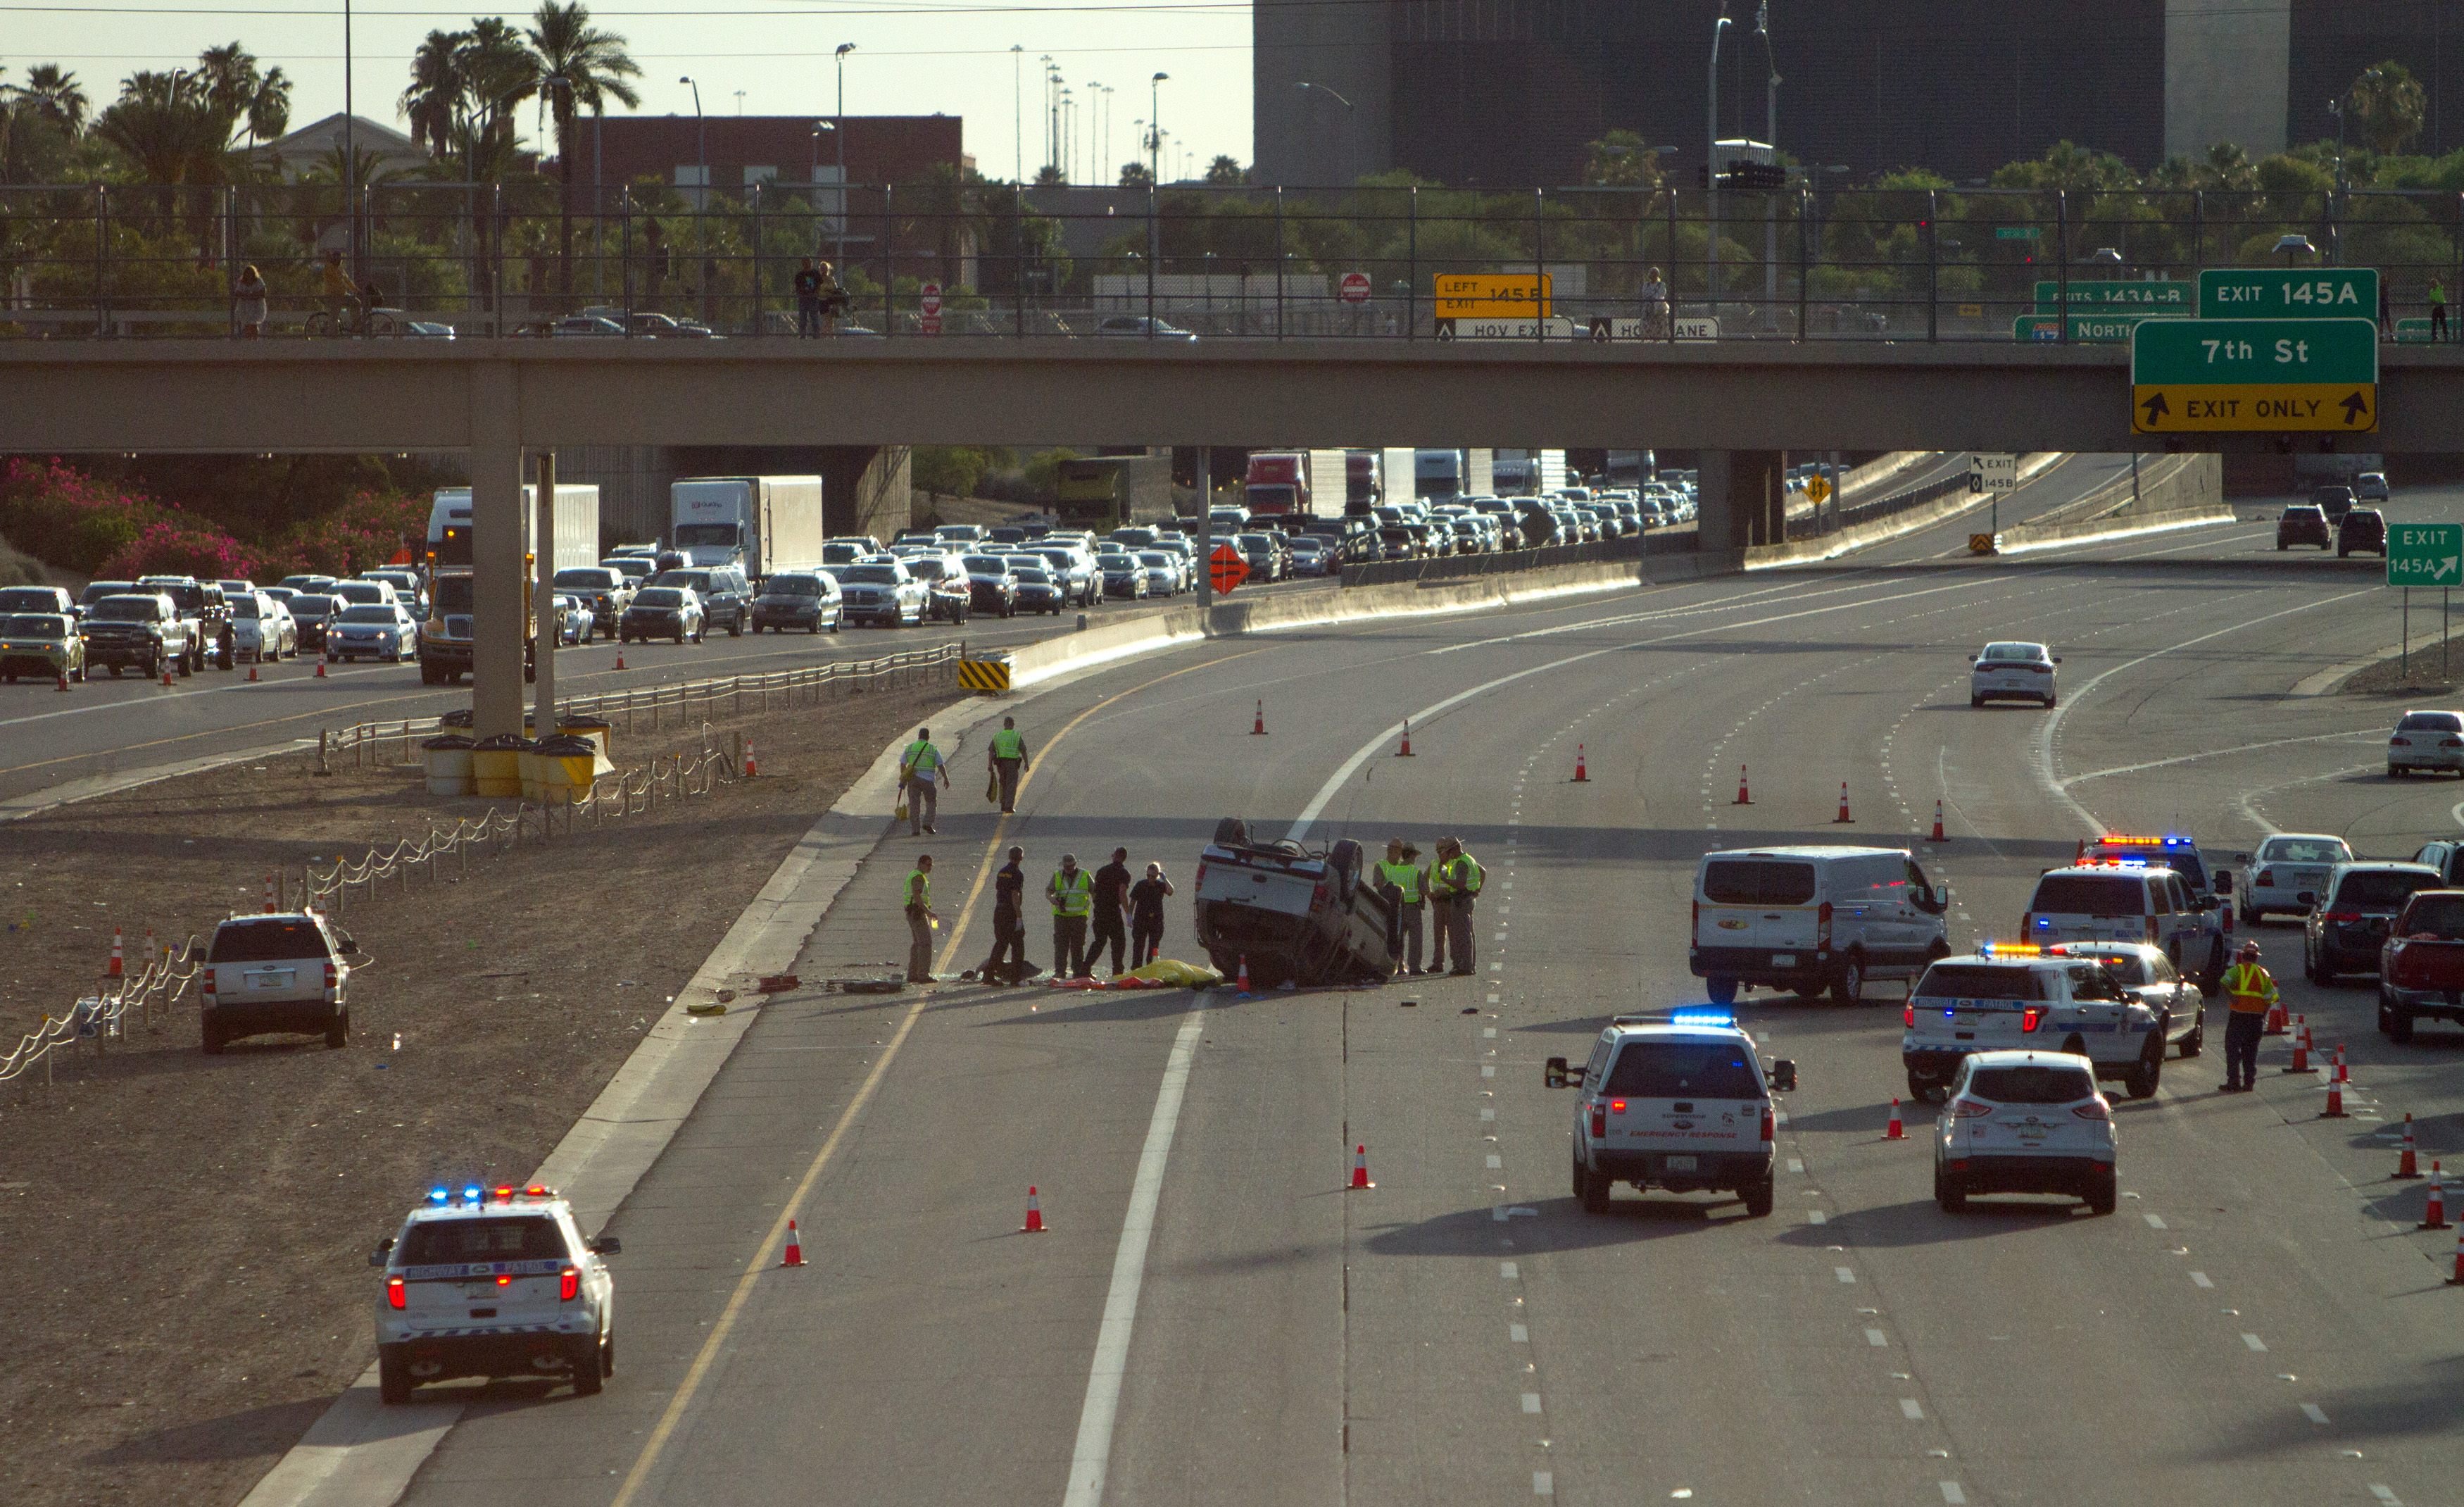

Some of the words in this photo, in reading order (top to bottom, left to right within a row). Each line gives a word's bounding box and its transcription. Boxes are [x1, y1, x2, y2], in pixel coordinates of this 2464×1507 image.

[1445, 282, 1478, 292] LEFT
[2218, 286, 2263, 301] EXIT
[2282, 282, 2358, 304] 145A
[1447, 299, 1475, 309] EXIT
[1476, 326, 1508, 337] HOV
[1519, 326, 1553, 337] EXT
[1673, 325, 1707, 337] ANE
[2201, 339, 2254, 363] 7th
[2275, 339, 2309, 363] St
[2187, 400, 2241, 418] EXIT
[2256, 399, 2321, 418] ONLY
[1987, 459, 2013, 468] EXIT
[1985, 479, 2013, 487] 145B
[2403, 531, 2448, 545] EXIT
[2390, 558, 2436, 573] 145A
[1983, 999, 2012, 1010] PATROL
[410, 1266, 463, 1277] HIGHWAY
[505, 1262, 546, 1274] PATROL
